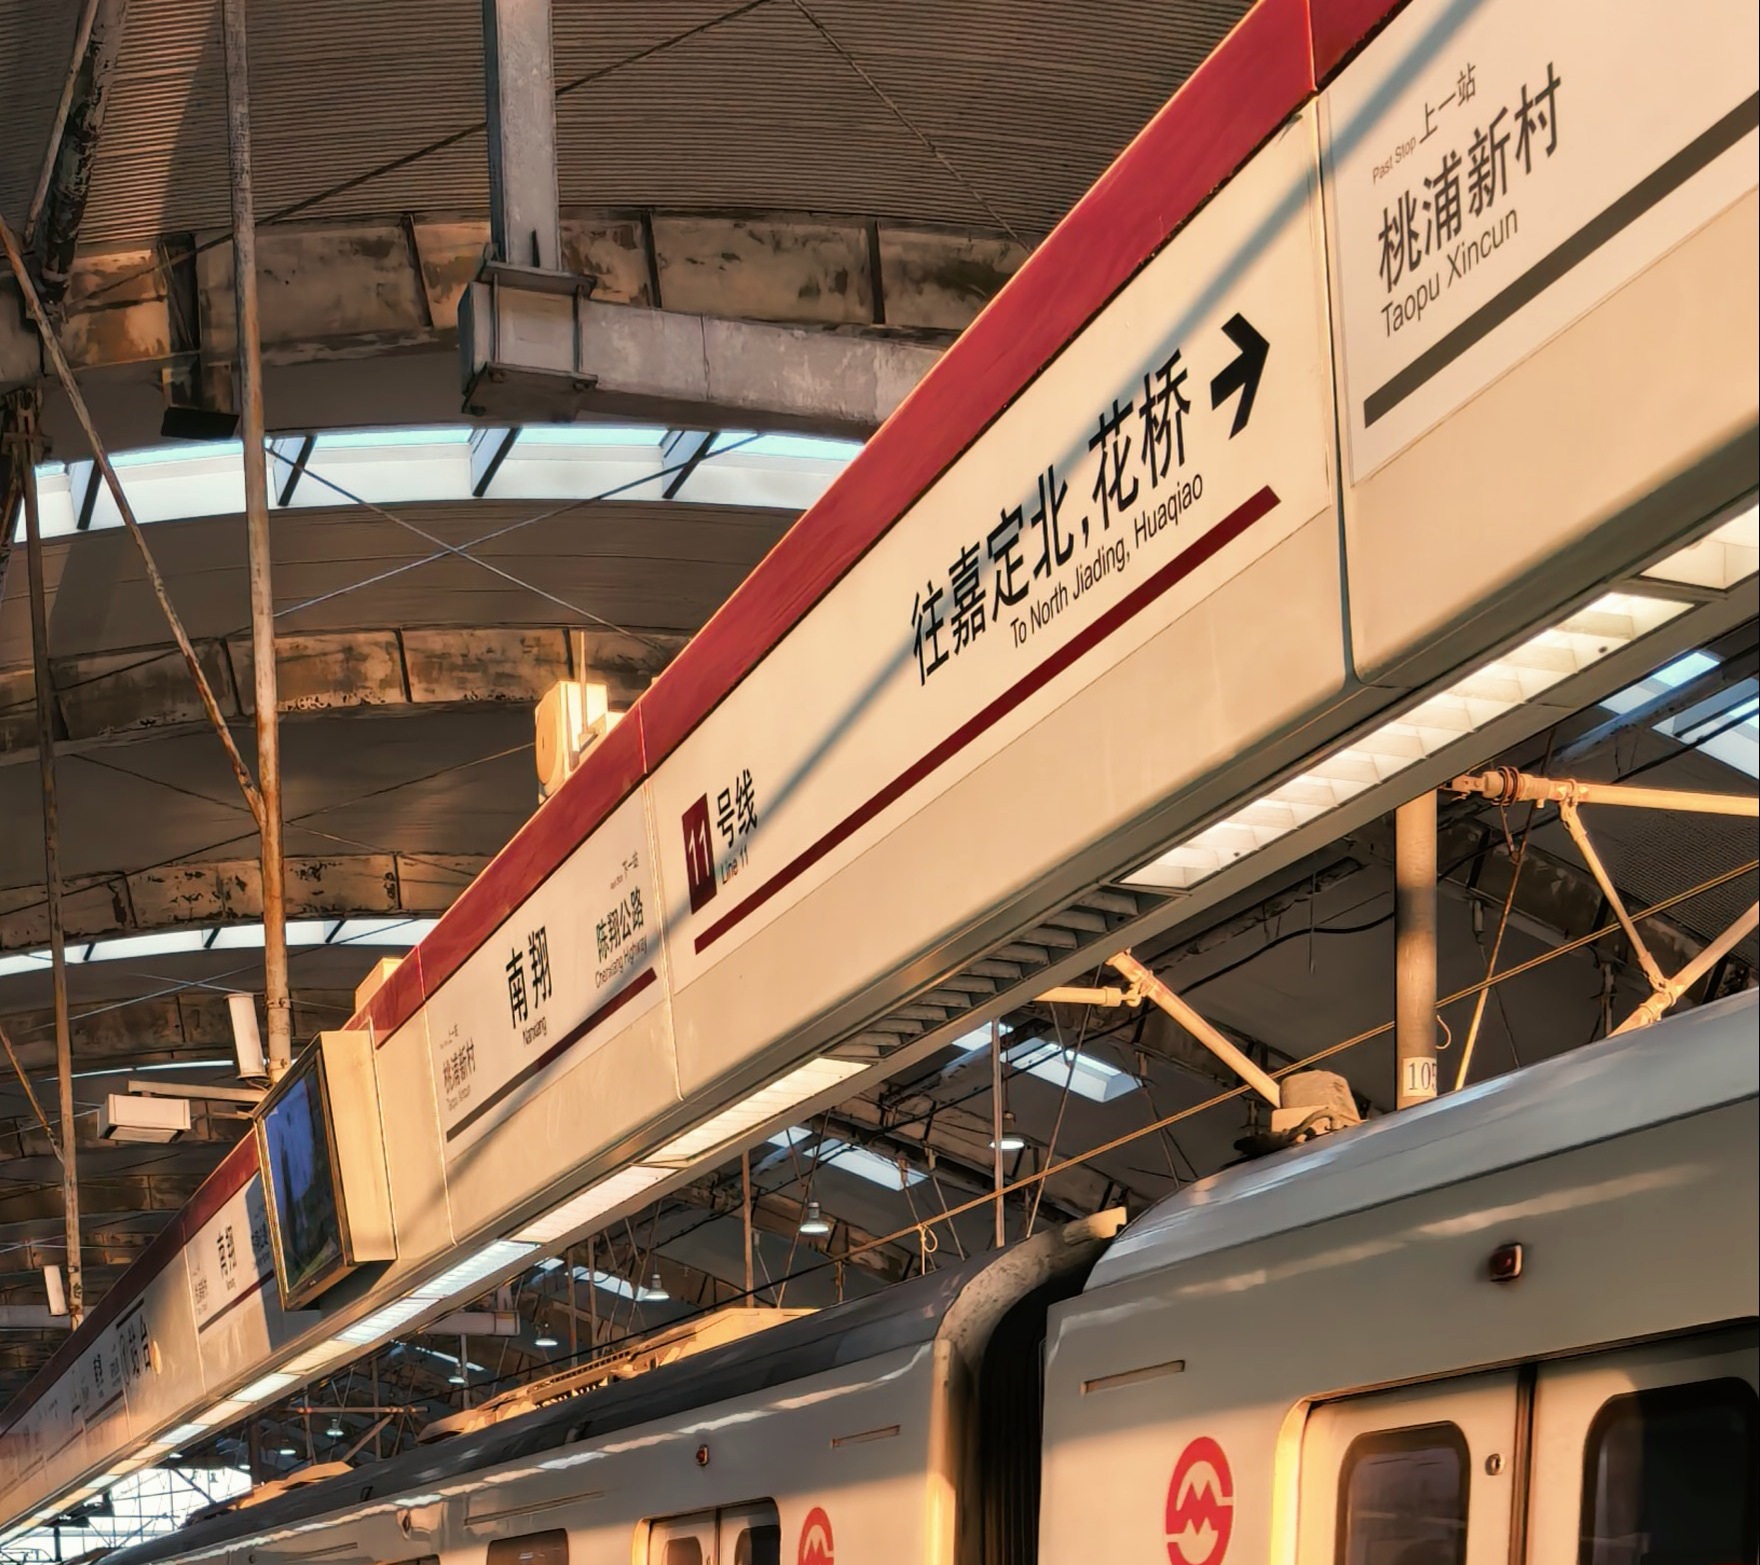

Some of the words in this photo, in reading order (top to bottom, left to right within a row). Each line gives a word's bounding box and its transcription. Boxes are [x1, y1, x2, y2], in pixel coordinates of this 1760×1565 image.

[1419, 62, 1476, 144] 上一站
[1373, 156, 1393, 185] Past
[1395, 137, 1416, 164] Stop
[1377, 61, 1561, 293] 桃浦新村
[1381, 269, 1440, 338] Taopu
[1447, 208, 1519, 288] Xincun
[1010, 618, 1027, 648] To
[1031, 582, 1068, 635] North
[1073, 536, 1131, 601] Jiading,
[1134, 473, 1203, 548] Huaqiao
[717, 769, 758, 848] 号线
[689, 820, 710, 886] 11
[721, 858, 739, 885] Line
[739, 844, 749, 868] 11
[596, 886, 644, 963] 陈翔公路
[506, 925, 552, 1029] 南翔
